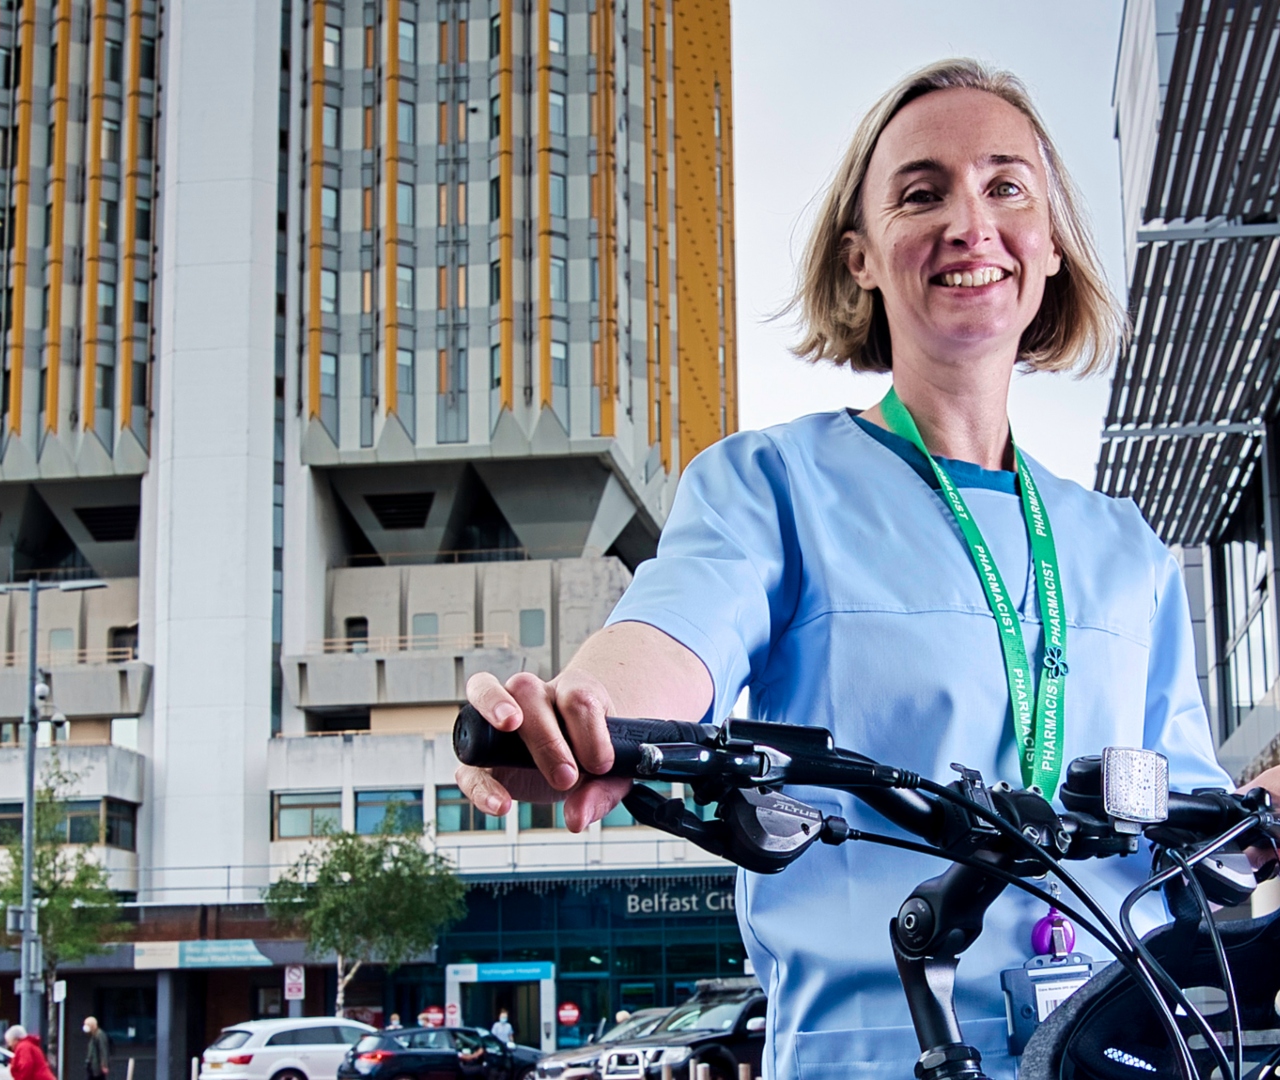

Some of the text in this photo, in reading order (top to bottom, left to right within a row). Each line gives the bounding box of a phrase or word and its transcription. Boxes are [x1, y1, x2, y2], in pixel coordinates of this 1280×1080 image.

[1021, 464, 1048, 537] PHARMACIST
[974, 544, 1017, 636] PHARMACIST
[1041, 560, 1063, 647] PHARMACIST
[773, 800, 819, 819] ALTUS
[627, 891, 735, 913] Belfast Cit
